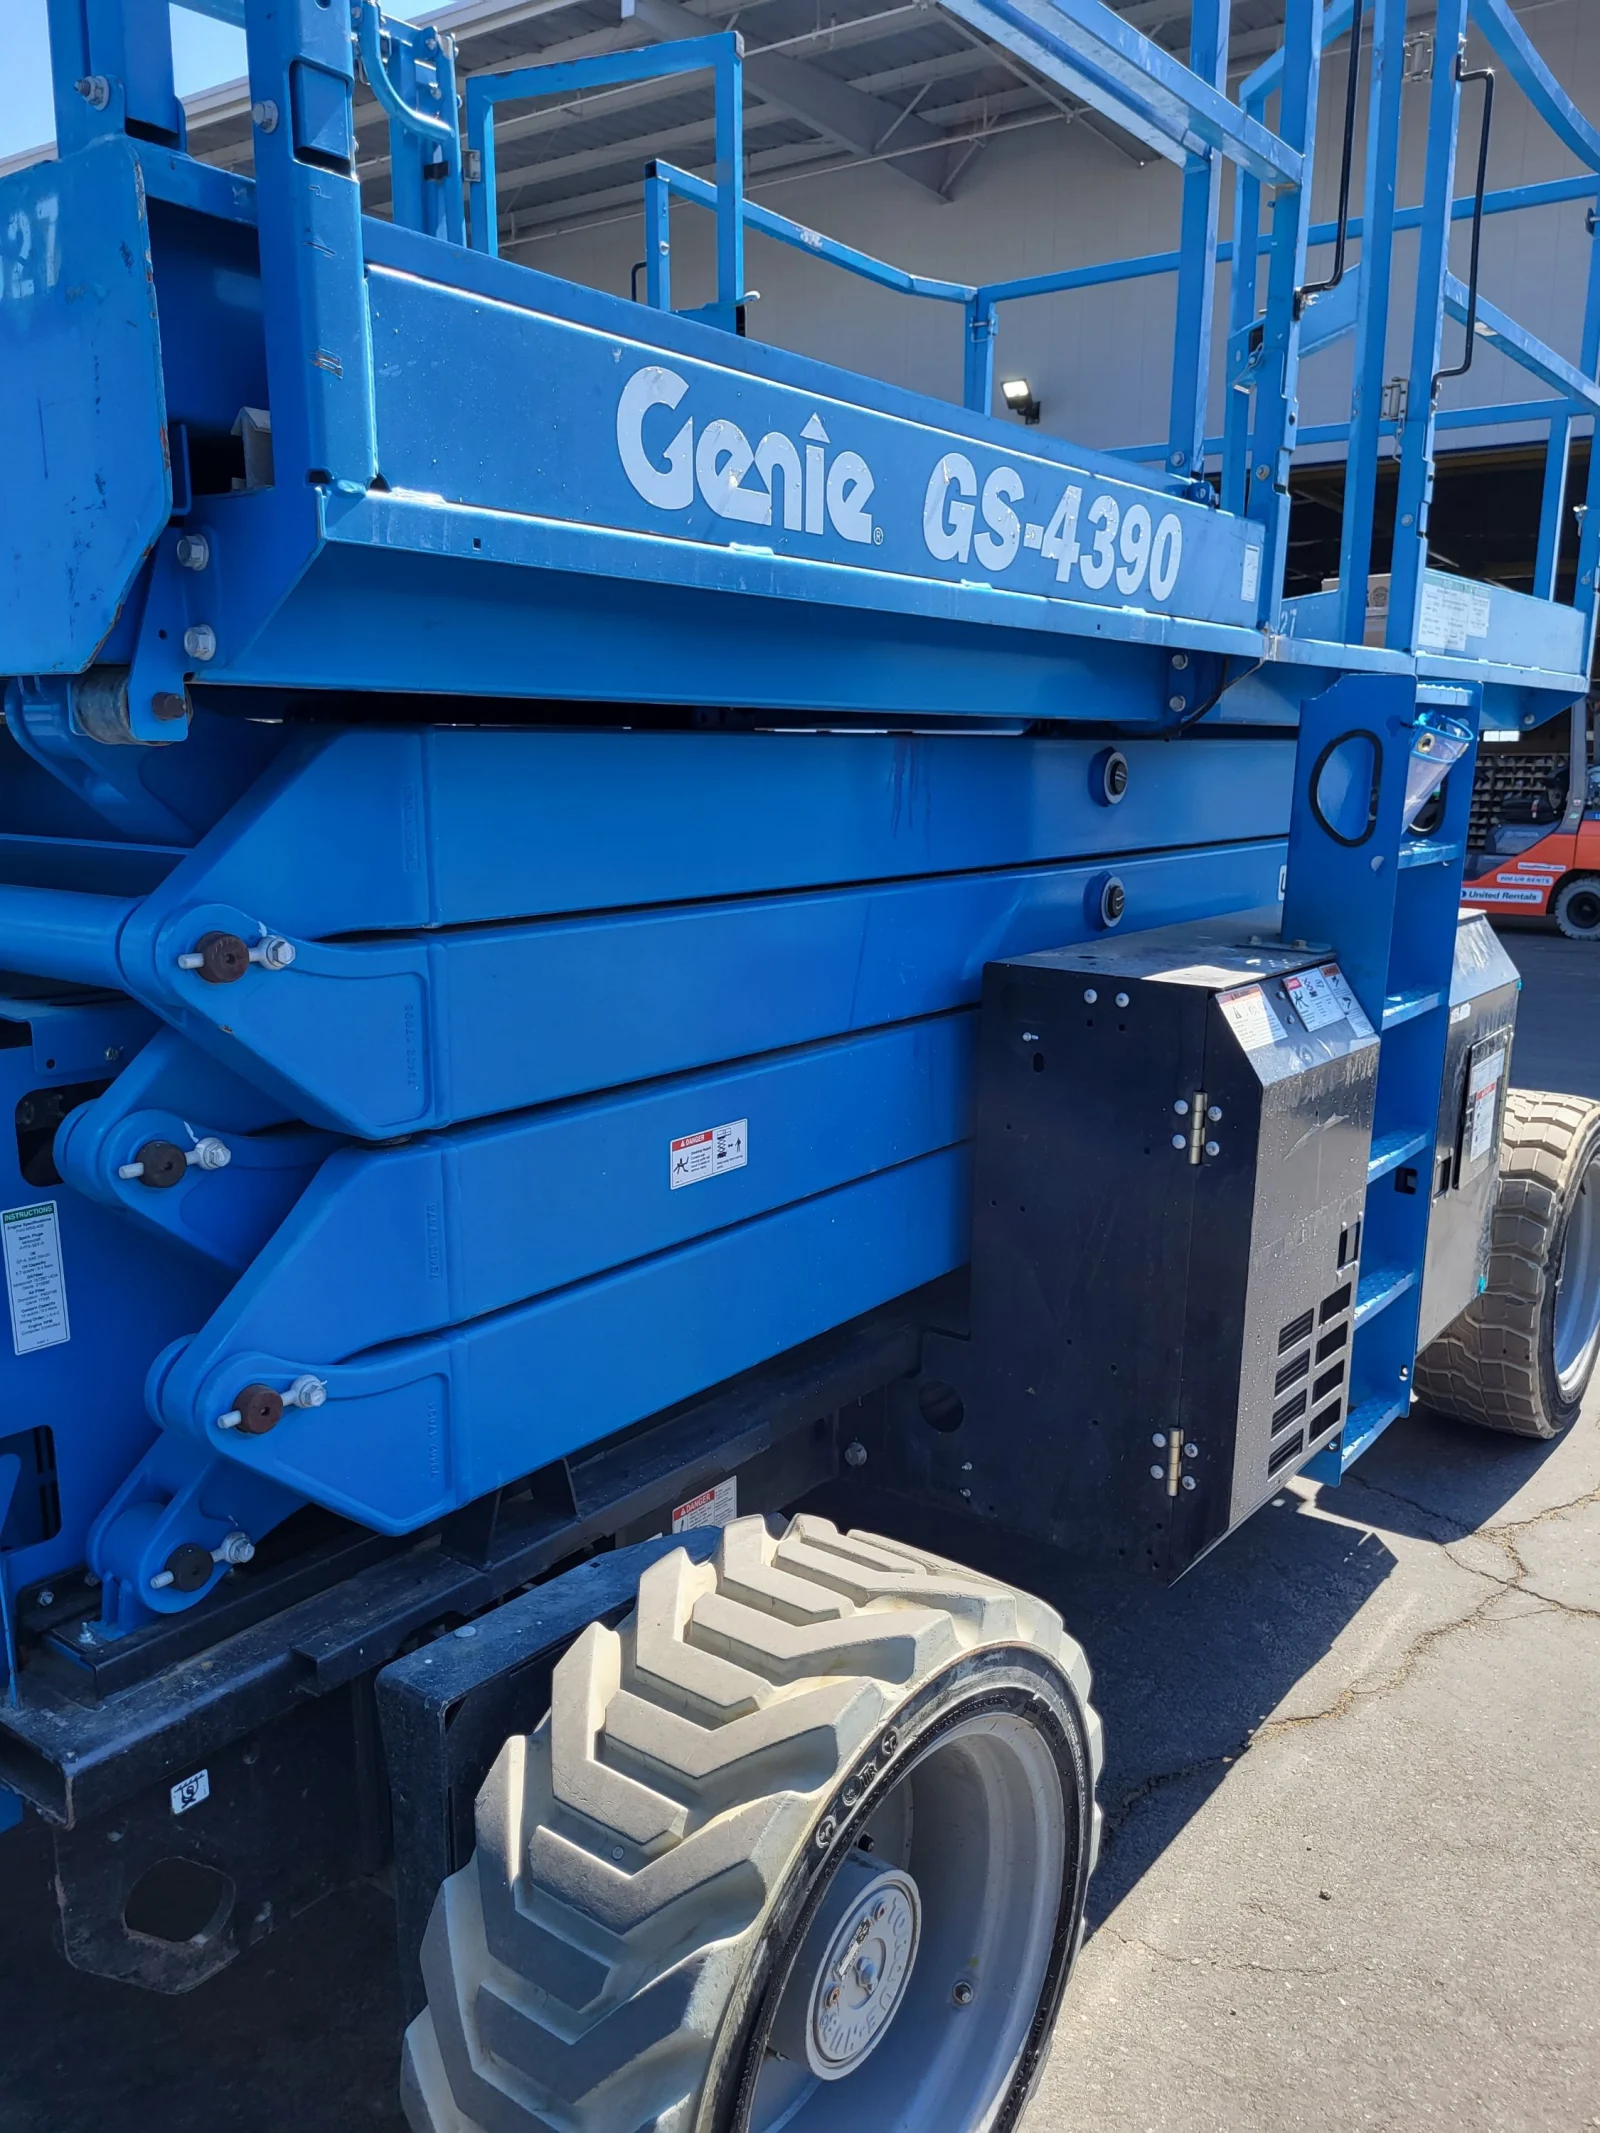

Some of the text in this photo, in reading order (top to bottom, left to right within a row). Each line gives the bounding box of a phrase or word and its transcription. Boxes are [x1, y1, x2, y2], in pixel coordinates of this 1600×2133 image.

[0, 197, 59, 300] 27
[923, 452, 1182, 602] GS-4390
[1468, 890, 1537, 900] United Rentals
[685, 1134, 705, 1146] DANGER
[4, 1205, 53, 1222] INSTRUCTIONS
[686, 1493, 711, 1513] DANGER
